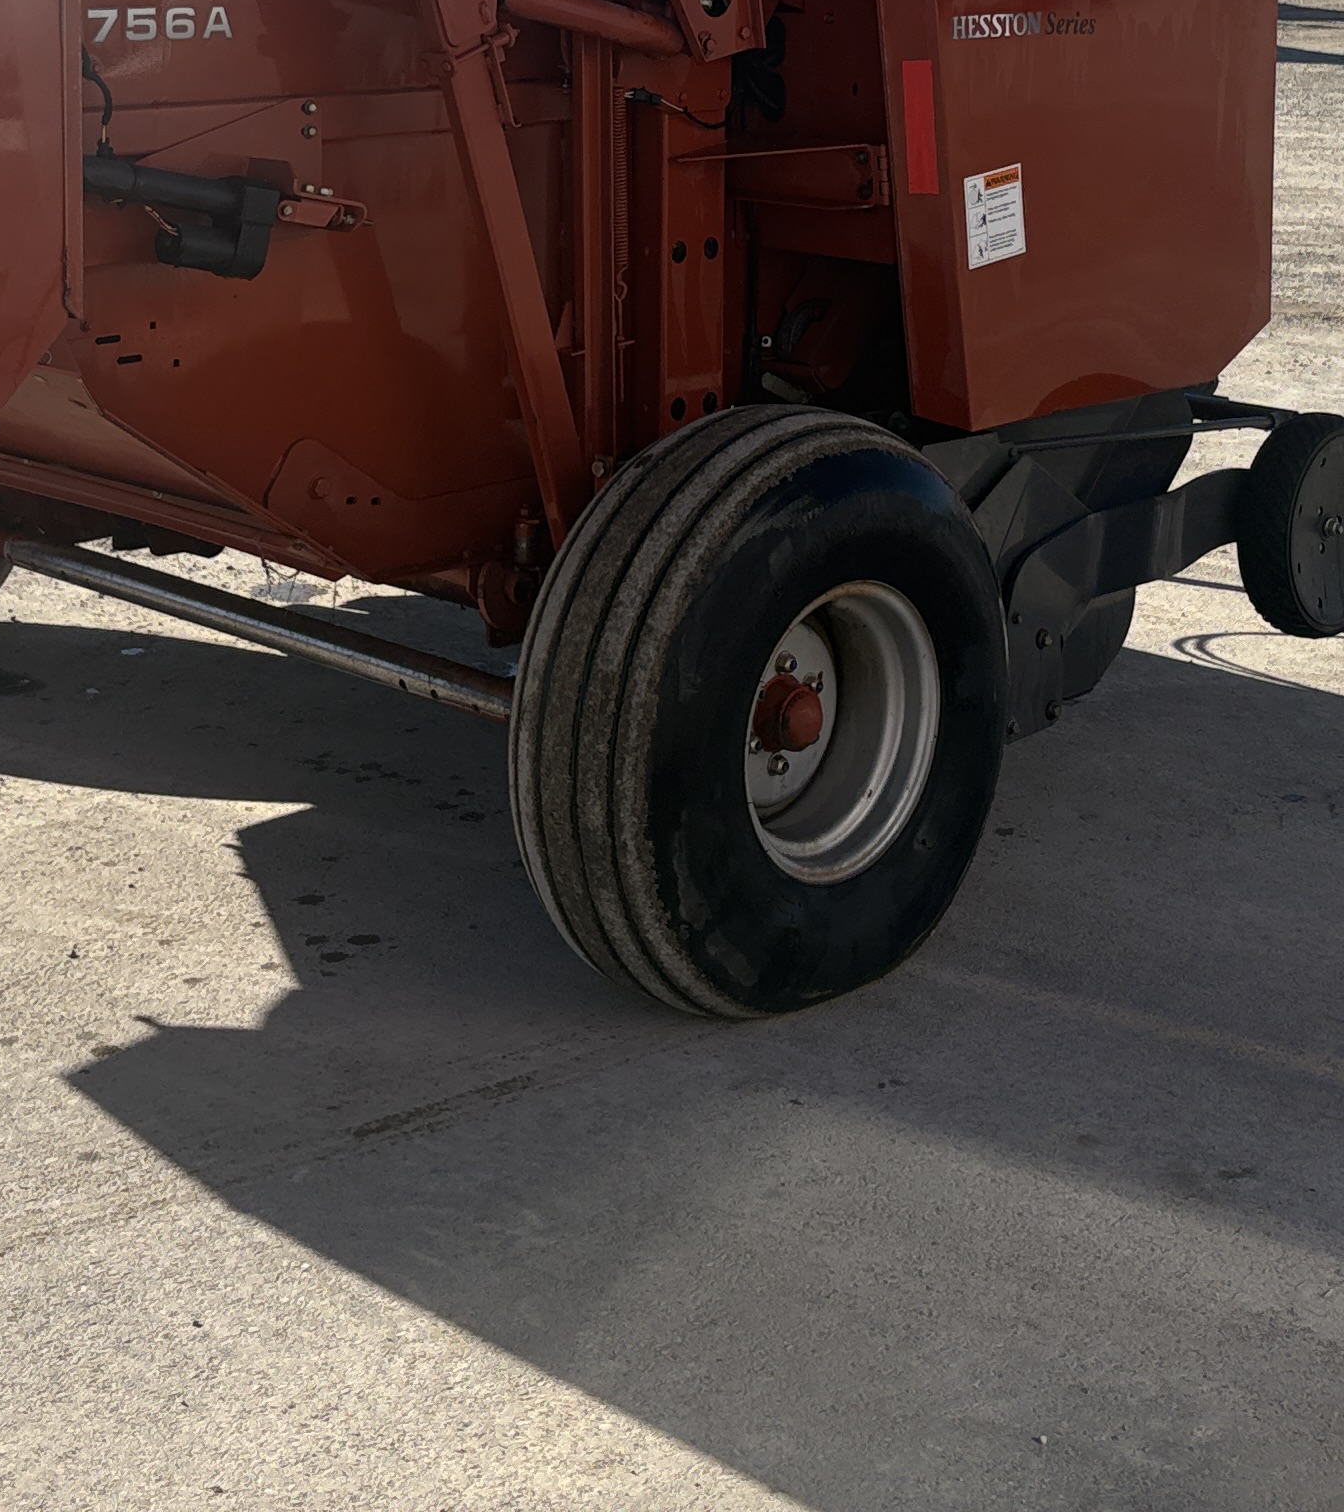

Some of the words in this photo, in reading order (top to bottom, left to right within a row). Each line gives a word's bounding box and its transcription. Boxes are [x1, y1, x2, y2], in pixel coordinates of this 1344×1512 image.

[87, 6, 233, 43] 756A
[952, 11, 1042, 40] HESSTON
[1045, 11, 1097, 36] Series
